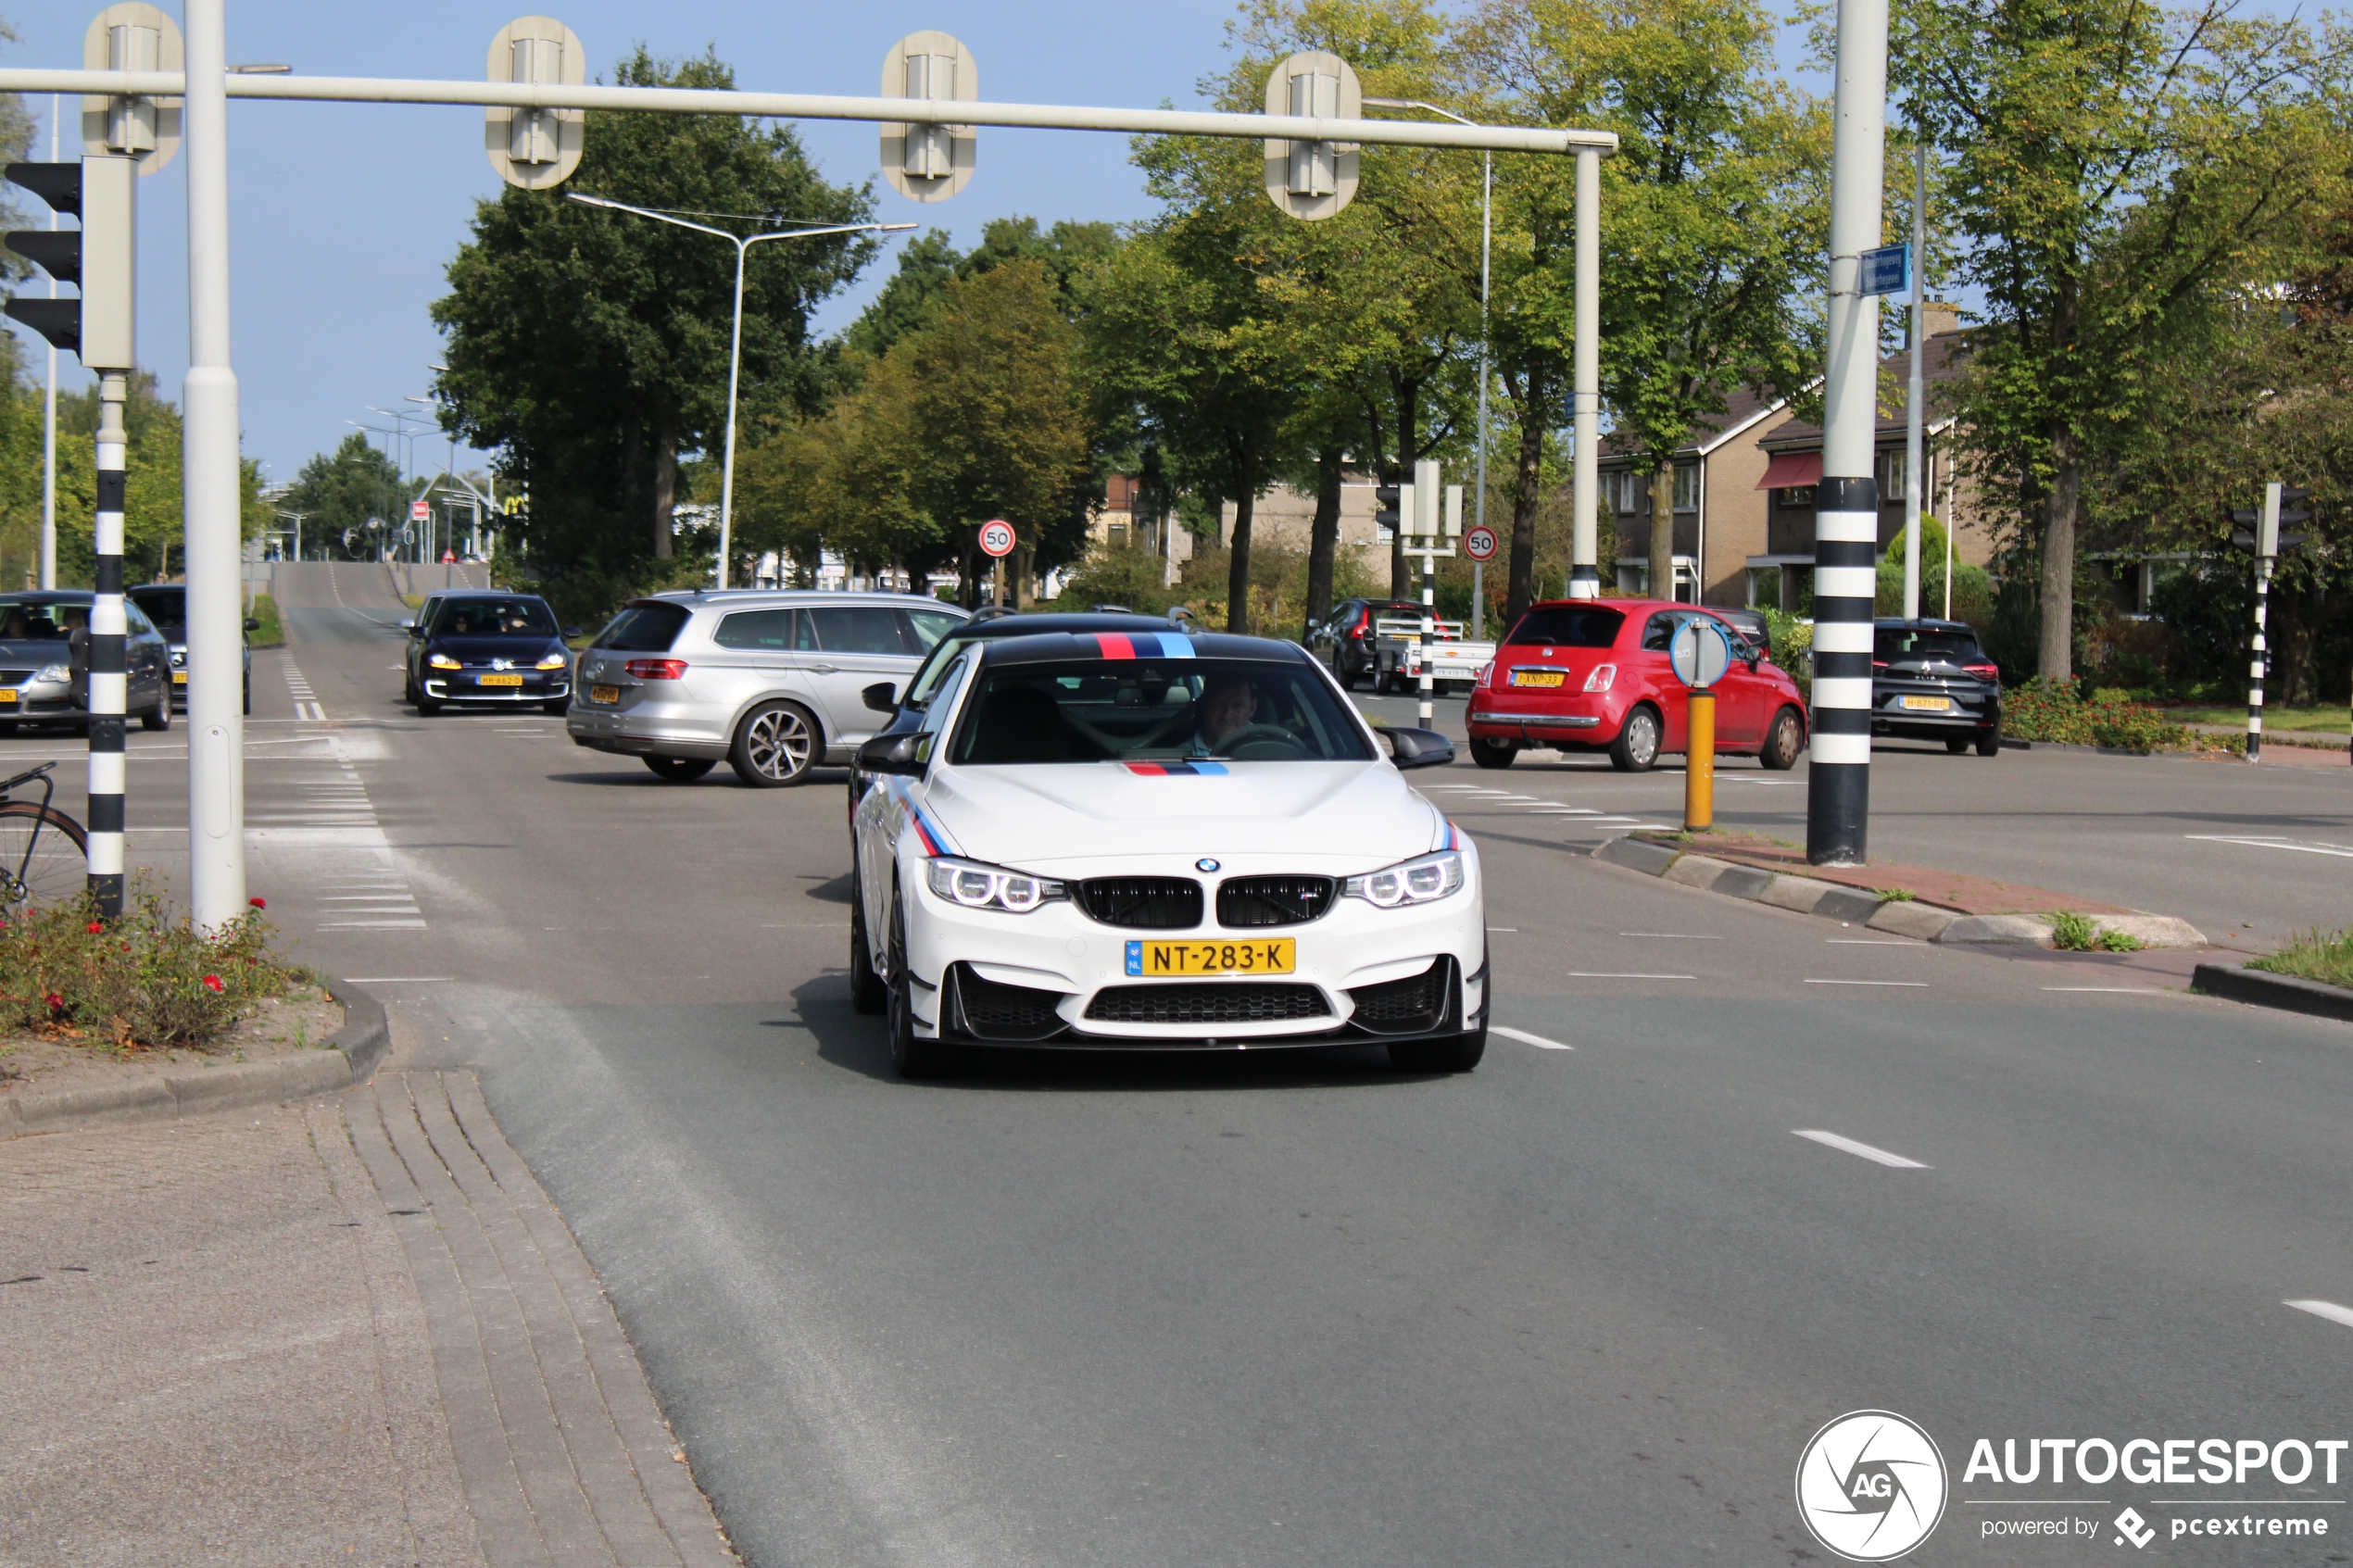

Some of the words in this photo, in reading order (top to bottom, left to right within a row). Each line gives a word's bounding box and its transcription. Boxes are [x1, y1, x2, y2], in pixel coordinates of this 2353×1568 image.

[987, 532, 1008, 546] 50
[1471, 536, 1491, 550] 50
[1518, 674, 1558, 684] 1-XNP-33
[1906, 698, 1946, 709] H-871-BP
[1128, 960, 1140, 971] NL
[1153, 944, 1283, 972] NT-283-K
